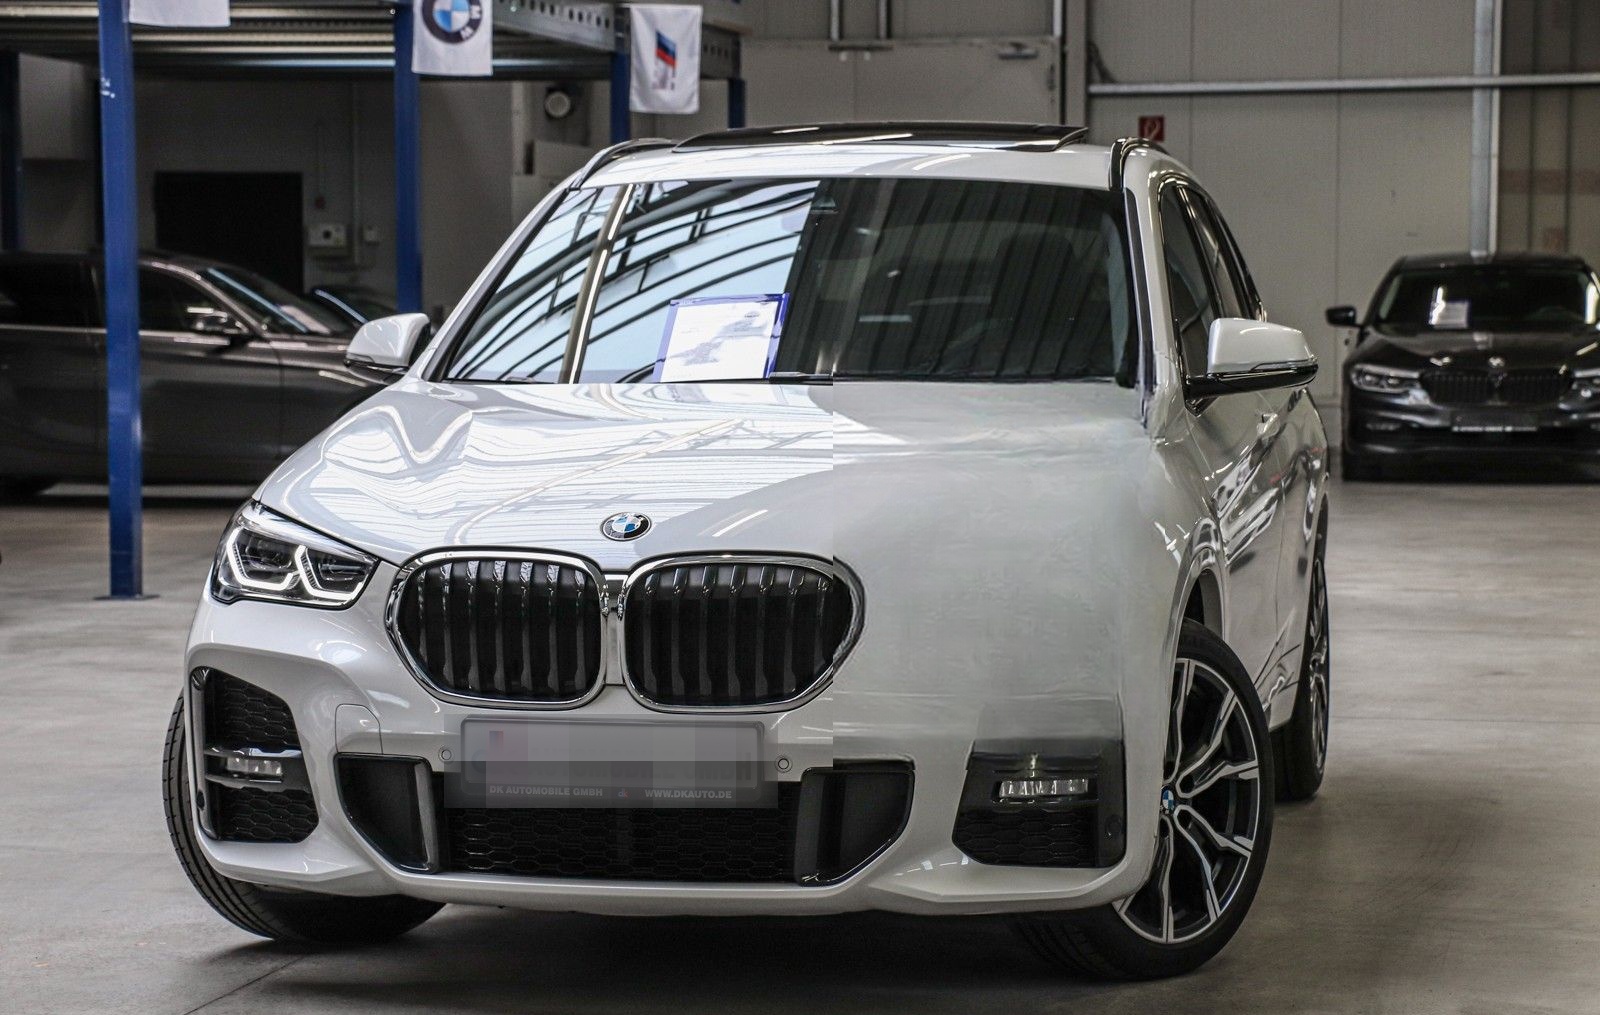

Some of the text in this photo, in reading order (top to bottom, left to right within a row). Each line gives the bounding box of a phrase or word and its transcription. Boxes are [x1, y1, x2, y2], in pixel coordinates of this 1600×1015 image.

[489, 785, 603, 797] DK AUTOMOBILE GMBH
[644, 789, 732, 799] WWW.DKAUTO.DE
